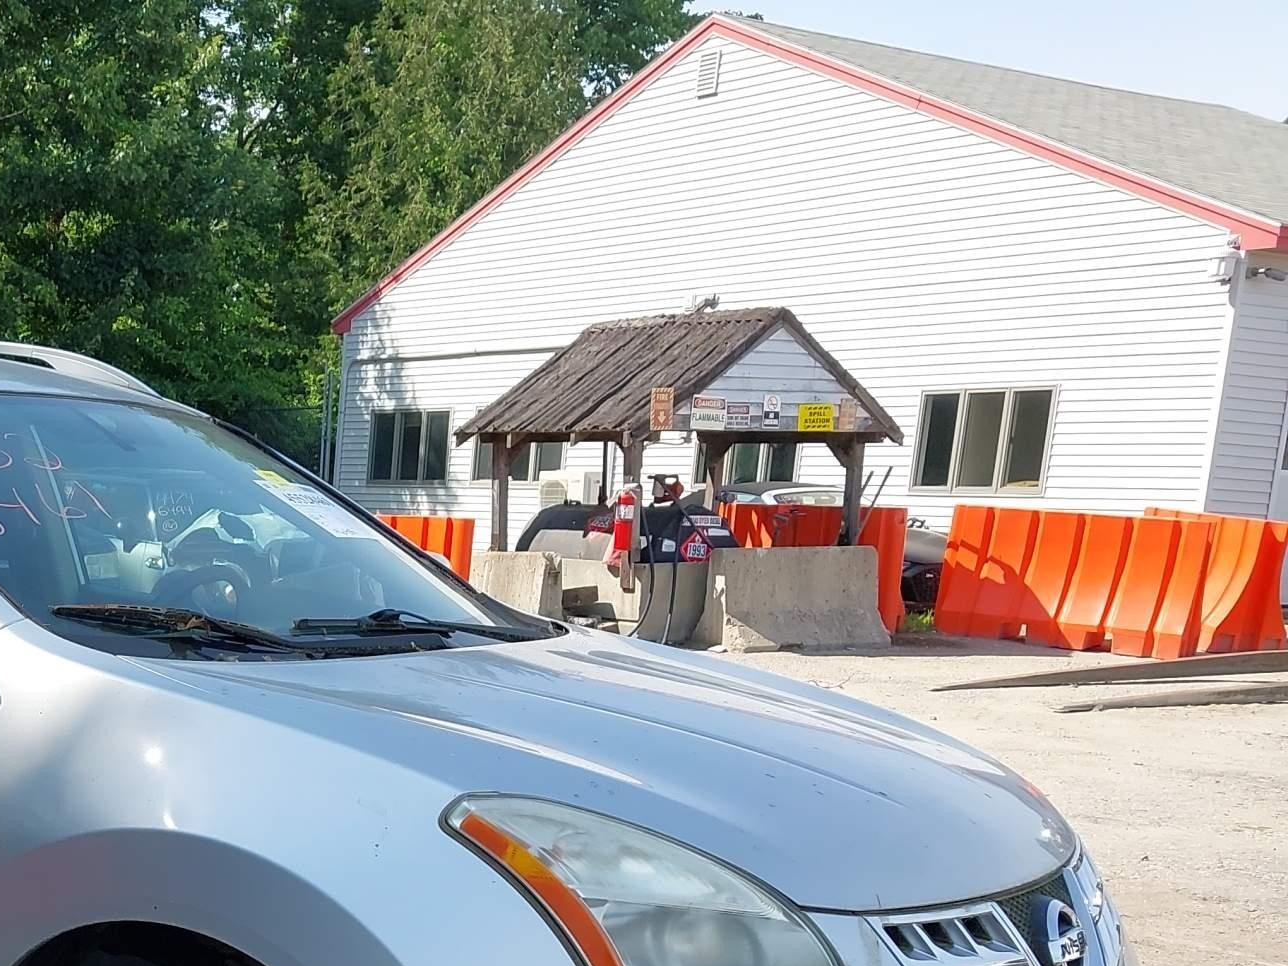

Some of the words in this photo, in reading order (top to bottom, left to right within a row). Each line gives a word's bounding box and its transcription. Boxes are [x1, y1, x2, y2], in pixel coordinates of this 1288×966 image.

[656, 393, 669, 401] FIRE
[697, 399, 721, 407] DANGER
[692, 412, 725, 423] FLAMMABLE
[689, 544, 706, 557] 1993
